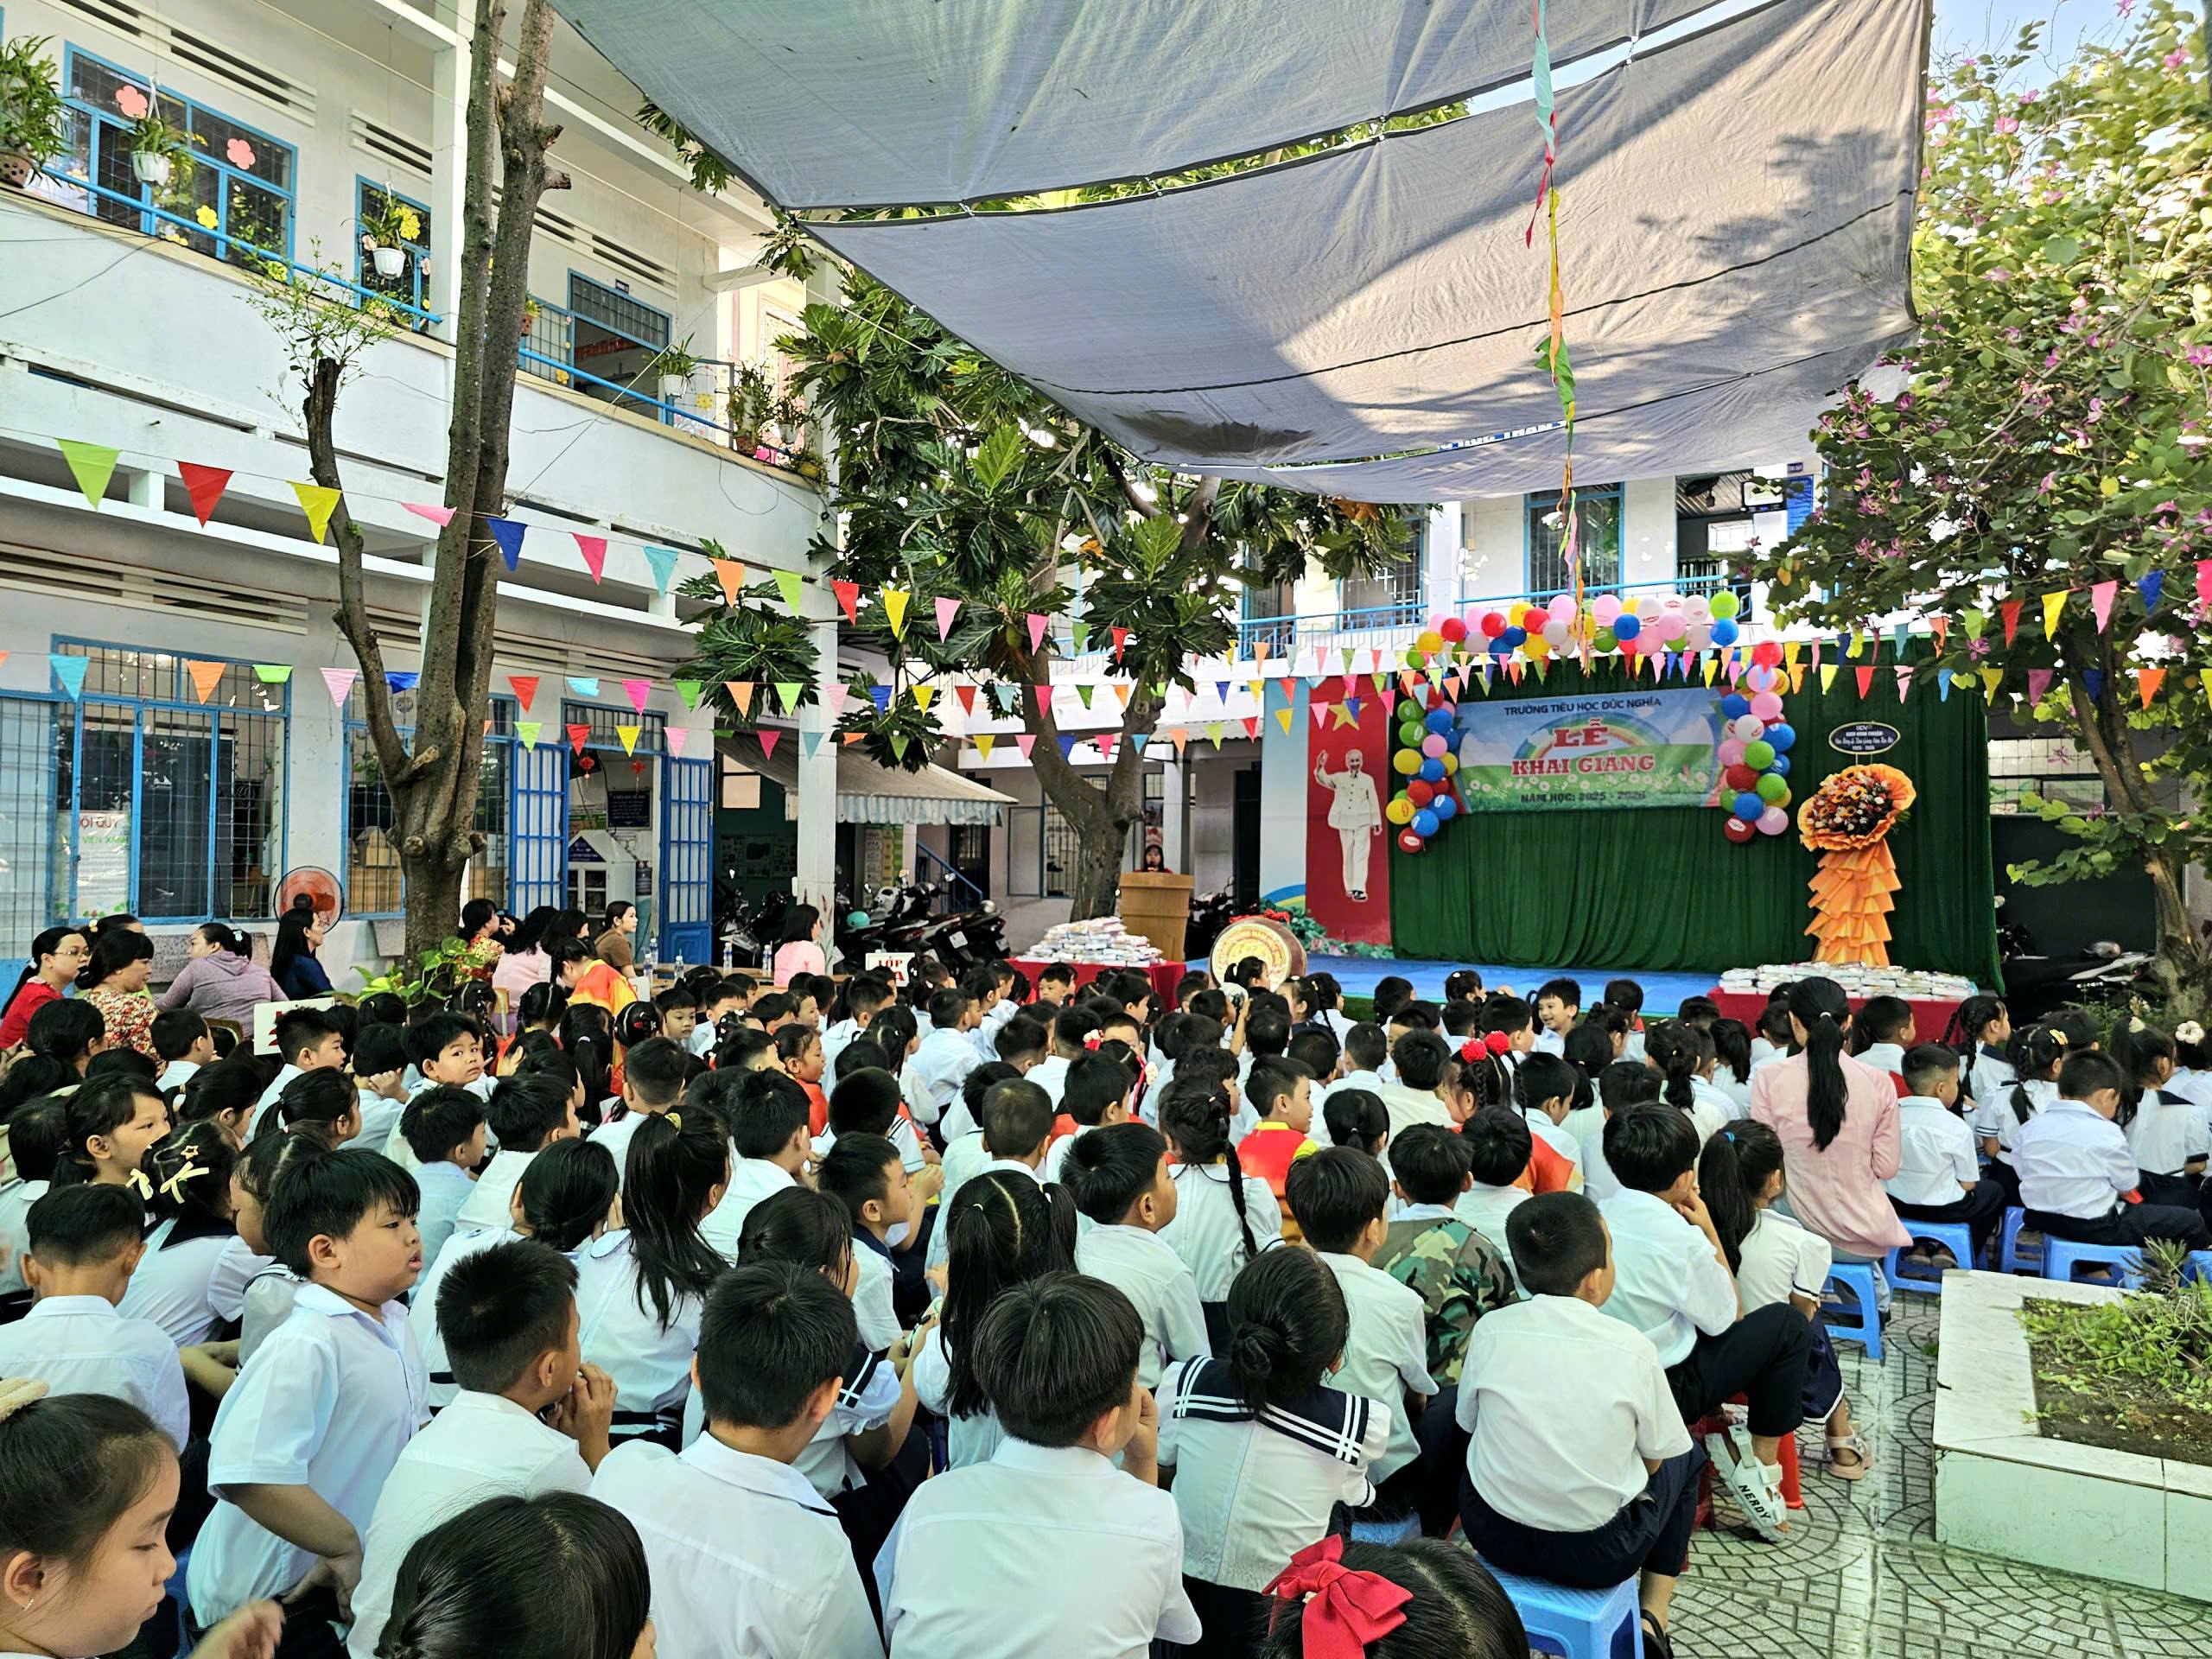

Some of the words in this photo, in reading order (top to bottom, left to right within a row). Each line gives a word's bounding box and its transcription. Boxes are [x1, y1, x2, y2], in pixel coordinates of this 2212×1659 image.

[1504, 703, 1548, 715] TRƯỜNG
[1550, 701, 1574, 713] TIỂU
[1577, 701, 1599, 712] HỌC
[1601, 698, 1624, 709] ĐỨC
[1626, 696, 1662, 709] NGHĨA
[1554, 718, 1608, 747] LỄ
[1512, 759, 1570, 775] KHAI
[1578, 752, 1654, 772] GIẢNG
[1738, 1484, 1770, 1518] NERDY
